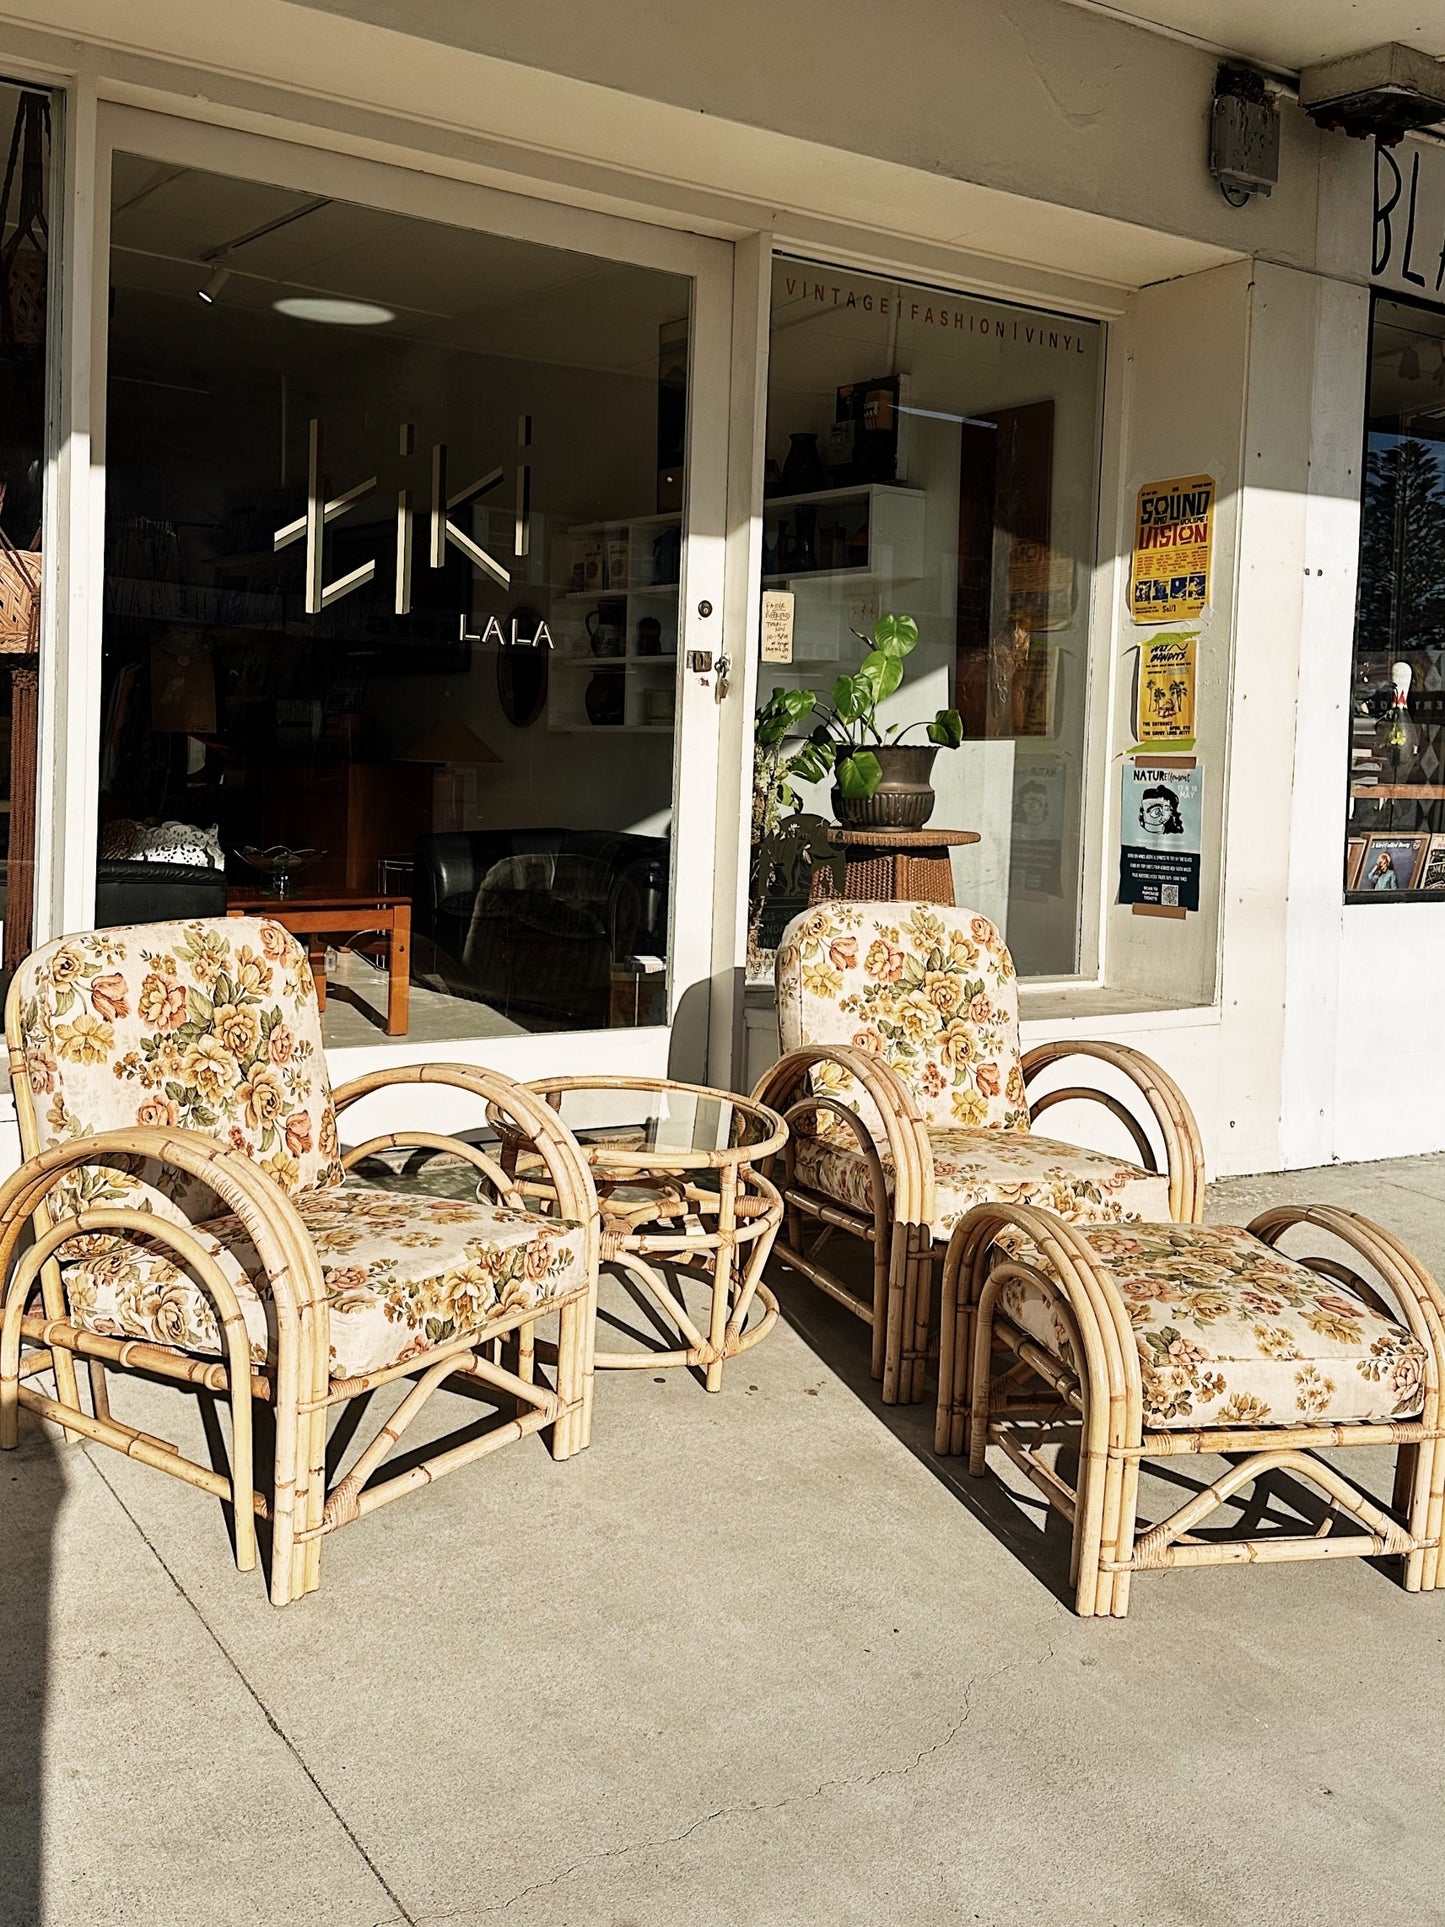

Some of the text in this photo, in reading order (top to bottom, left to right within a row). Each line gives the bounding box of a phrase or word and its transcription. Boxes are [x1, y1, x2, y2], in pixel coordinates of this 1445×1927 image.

[785, 277, 1085, 354] VINTAGE FASHION VINYL
[1141, 490, 1211, 526] SOUND
[1138, 523, 1209, 551] VISION
